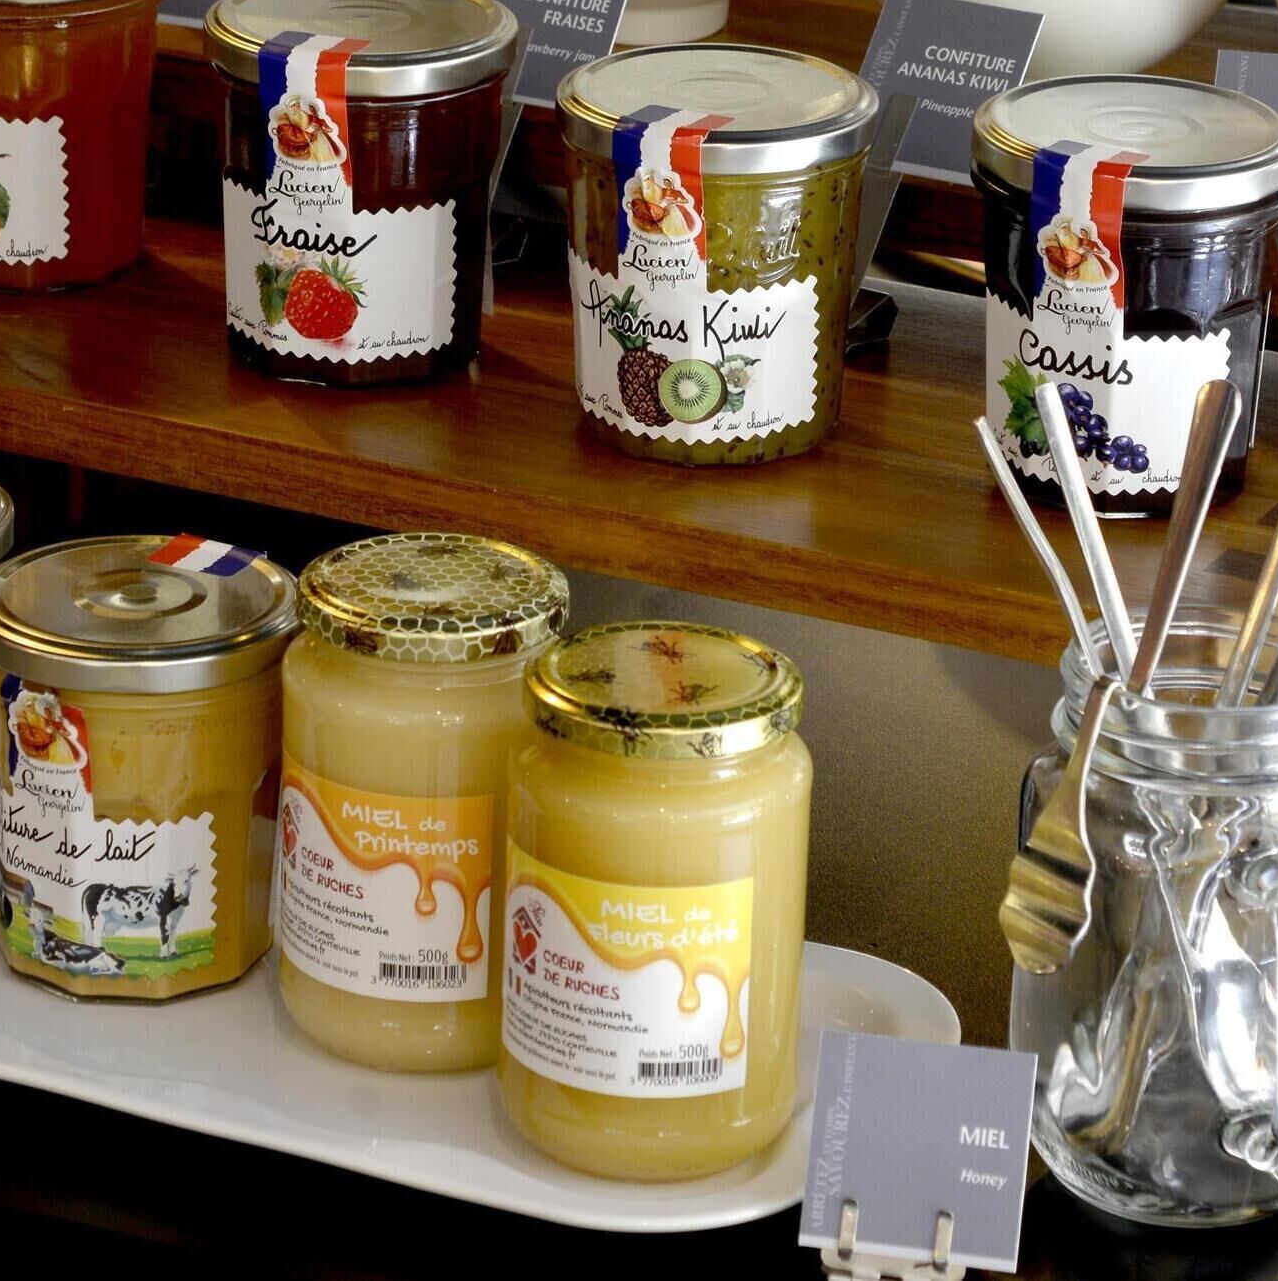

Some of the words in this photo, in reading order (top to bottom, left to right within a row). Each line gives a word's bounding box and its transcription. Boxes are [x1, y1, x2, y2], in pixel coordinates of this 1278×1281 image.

[543, 10, 605, 33] FRAISES
[527, 43, 572, 59] awberry
[573, 48, 595, 63] jam
[925, 45, 1016, 74] CONFITURE
[897, 61, 966, 86] ANANAS
[969, 73, 1009, 93] KIWI
[921, 98, 975, 119] Pineapple
[316, 163, 338, 172] France
[268, 169, 340, 196] Lucien
[293, 190, 346, 215] Georgelin
[251, 198, 377, 257] Fraise
[632, 232, 658, 247] Fabriqué
[669, 237, 691, 247] France
[6, 239, 49, 258] chaudron
[622, 245, 693, 273] Lucien
[646, 265, 699, 291] Georgelin
[1086, 285, 1108, 294] France
[1037, 289, 1109, 315] Lucien
[581, 279, 688, 348] Ananas
[703, 299, 786, 361] Kiwi
[1062, 313, 1114, 335] Georgelin
[371, 339, 385, 348] au
[386, 330, 430, 348] chaudron
[1019, 328, 1133, 386] Cassis
[726, 422, 741, 430] au
[747, 412, 784, 429] chaudron
[1108, 477, 1124, 485] au
[15, 769, 80, 799] Lucien
[38, 796, 86, 819] Georgelin
[342, 801, 408, 830] MIEL
[419, 817, 448, 832] de
[55, 829, 92, 859] de
[95, 829, 156, 861] lait
[355, 831, 479, 863] Printemps
[6, 846, 87, 888] Normandie
[301, 847, 334, 872] COEUR
[301, 864, 313, 882] DE
[317, 874, 365, 900] RUCHES
[323, 901, 374, 923] récoltants
[601, 899, 674, 924] MIEL
[683, 906, 712, 921] de
[336, 919, 389, 936] Normandie
[586, 922, 664, 949] Fleurs
[671, 920, 742, 947] d'été
[418, 949, 449, 965] 500g
[543, 949, 585, 974] COEUR
[371, 975, 377, 984] 3
[544, 968, 560, 986] DE
[564, 979, 621, 1001] RUCHES
[573, 1004, 633, 1022] récoltants
[588, 1020, 648, 1034] Normandie
[679, 1044, 709, 1059] 500g
[629, 1077, 635, 1086] 3
[960, 1125, 1010, 1150] MIEL
[960, 1169, 1008, 1191] Honey
